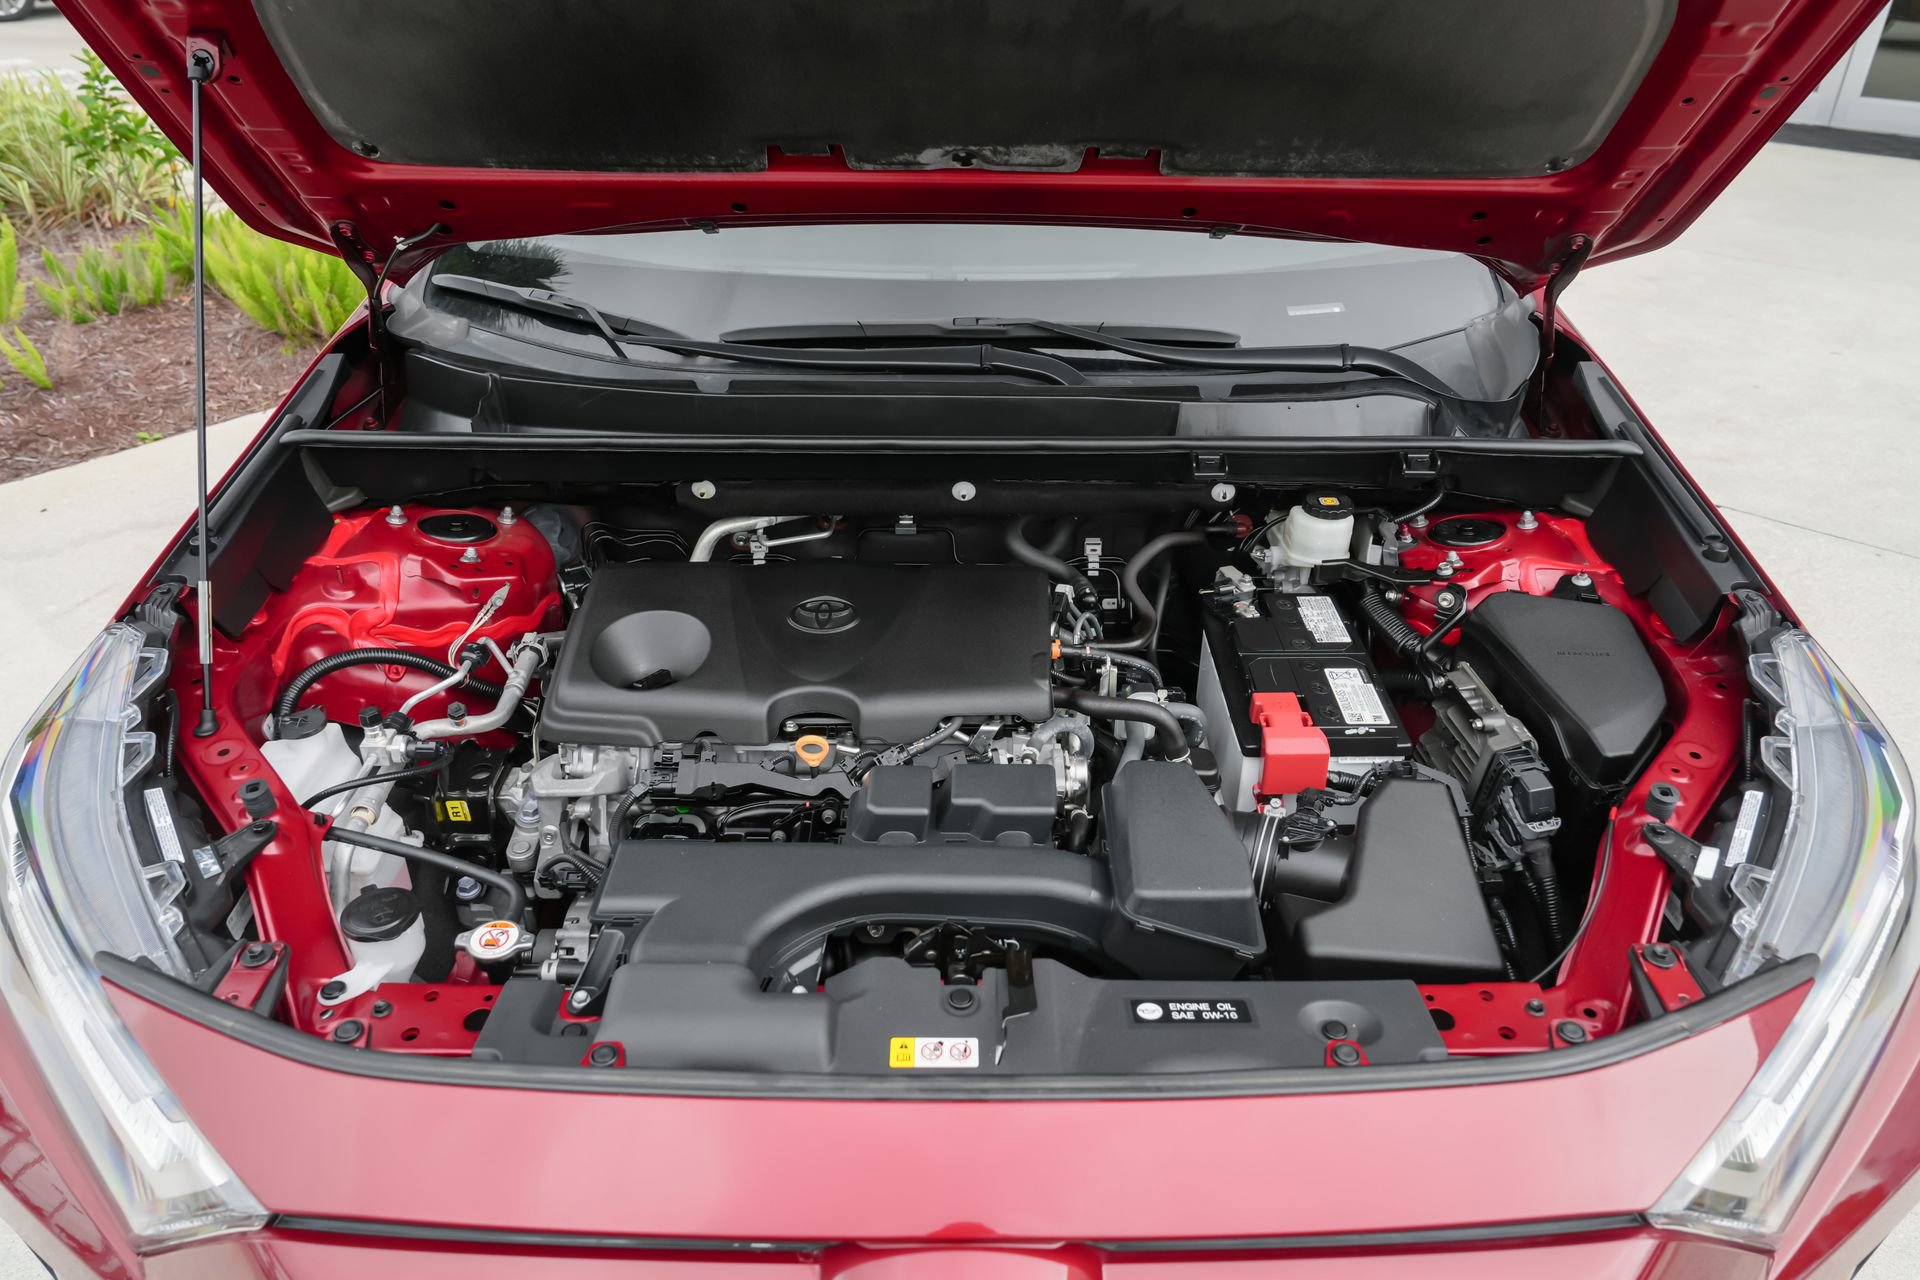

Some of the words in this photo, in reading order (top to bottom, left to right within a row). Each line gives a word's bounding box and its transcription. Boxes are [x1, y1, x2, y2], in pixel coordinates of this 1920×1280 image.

[1168, 1002, 1210, 1011] ENGINE
[1216, 1003, 1236, 1011] OIL
[1171, 1011, 1195, 1020] SAE
[1202, 1011, 1238, 1020] 0W-16
